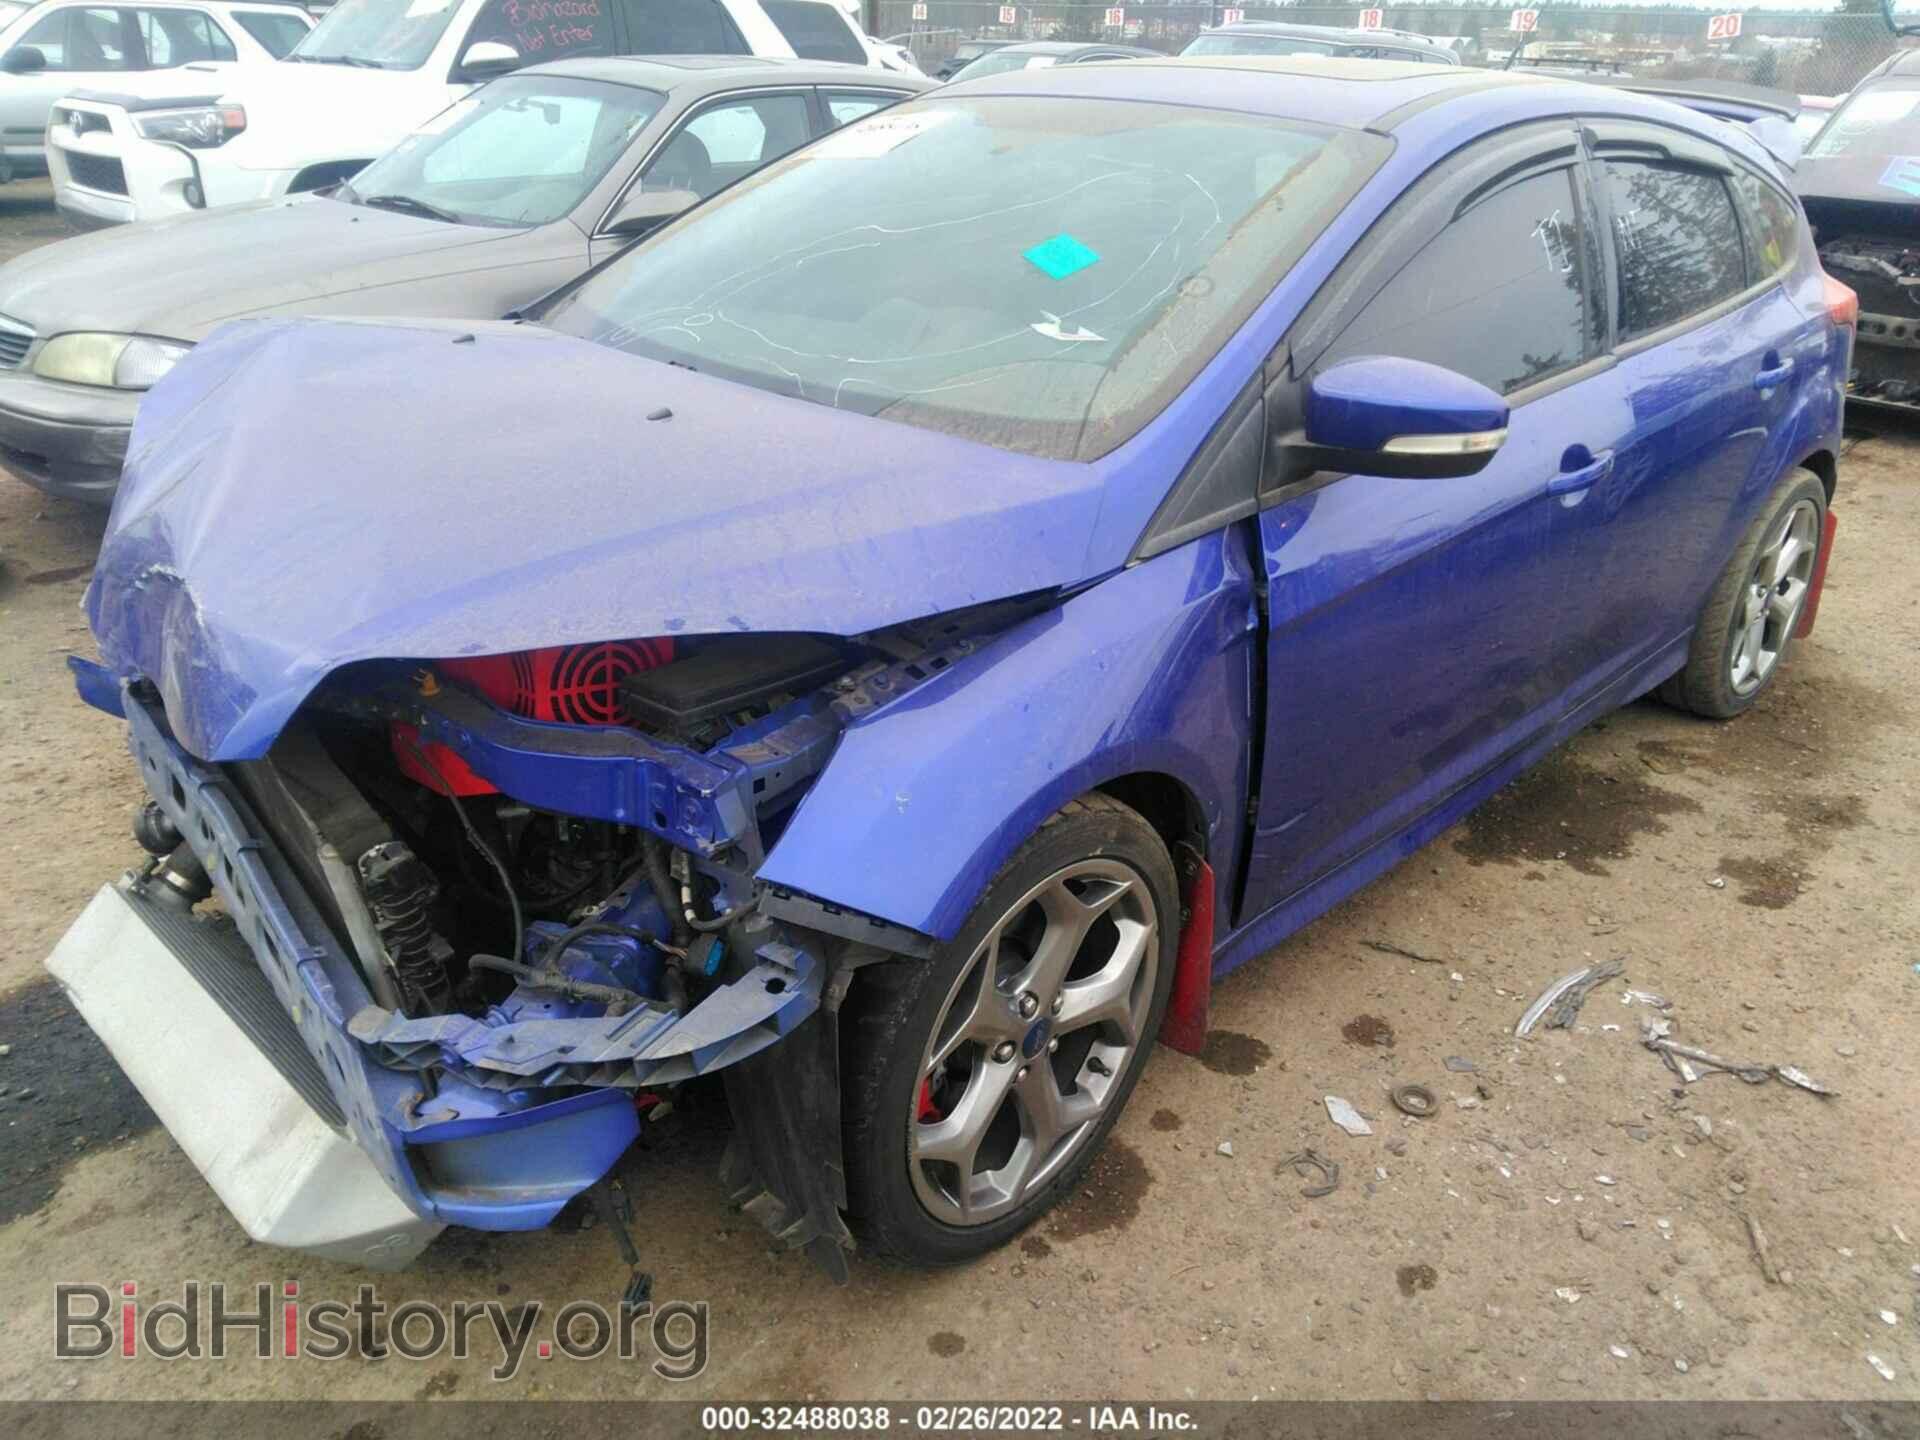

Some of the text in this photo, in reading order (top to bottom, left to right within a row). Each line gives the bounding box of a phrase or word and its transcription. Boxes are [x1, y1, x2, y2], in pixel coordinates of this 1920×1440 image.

[1002, 7, 1013, 22] 15
[1108, 9, 1121, 24] 16
[1363, 10, 1378, 28] 18
[1516, 12, 1536, 30] 19
[1711, 15, 1738, 36] 20
